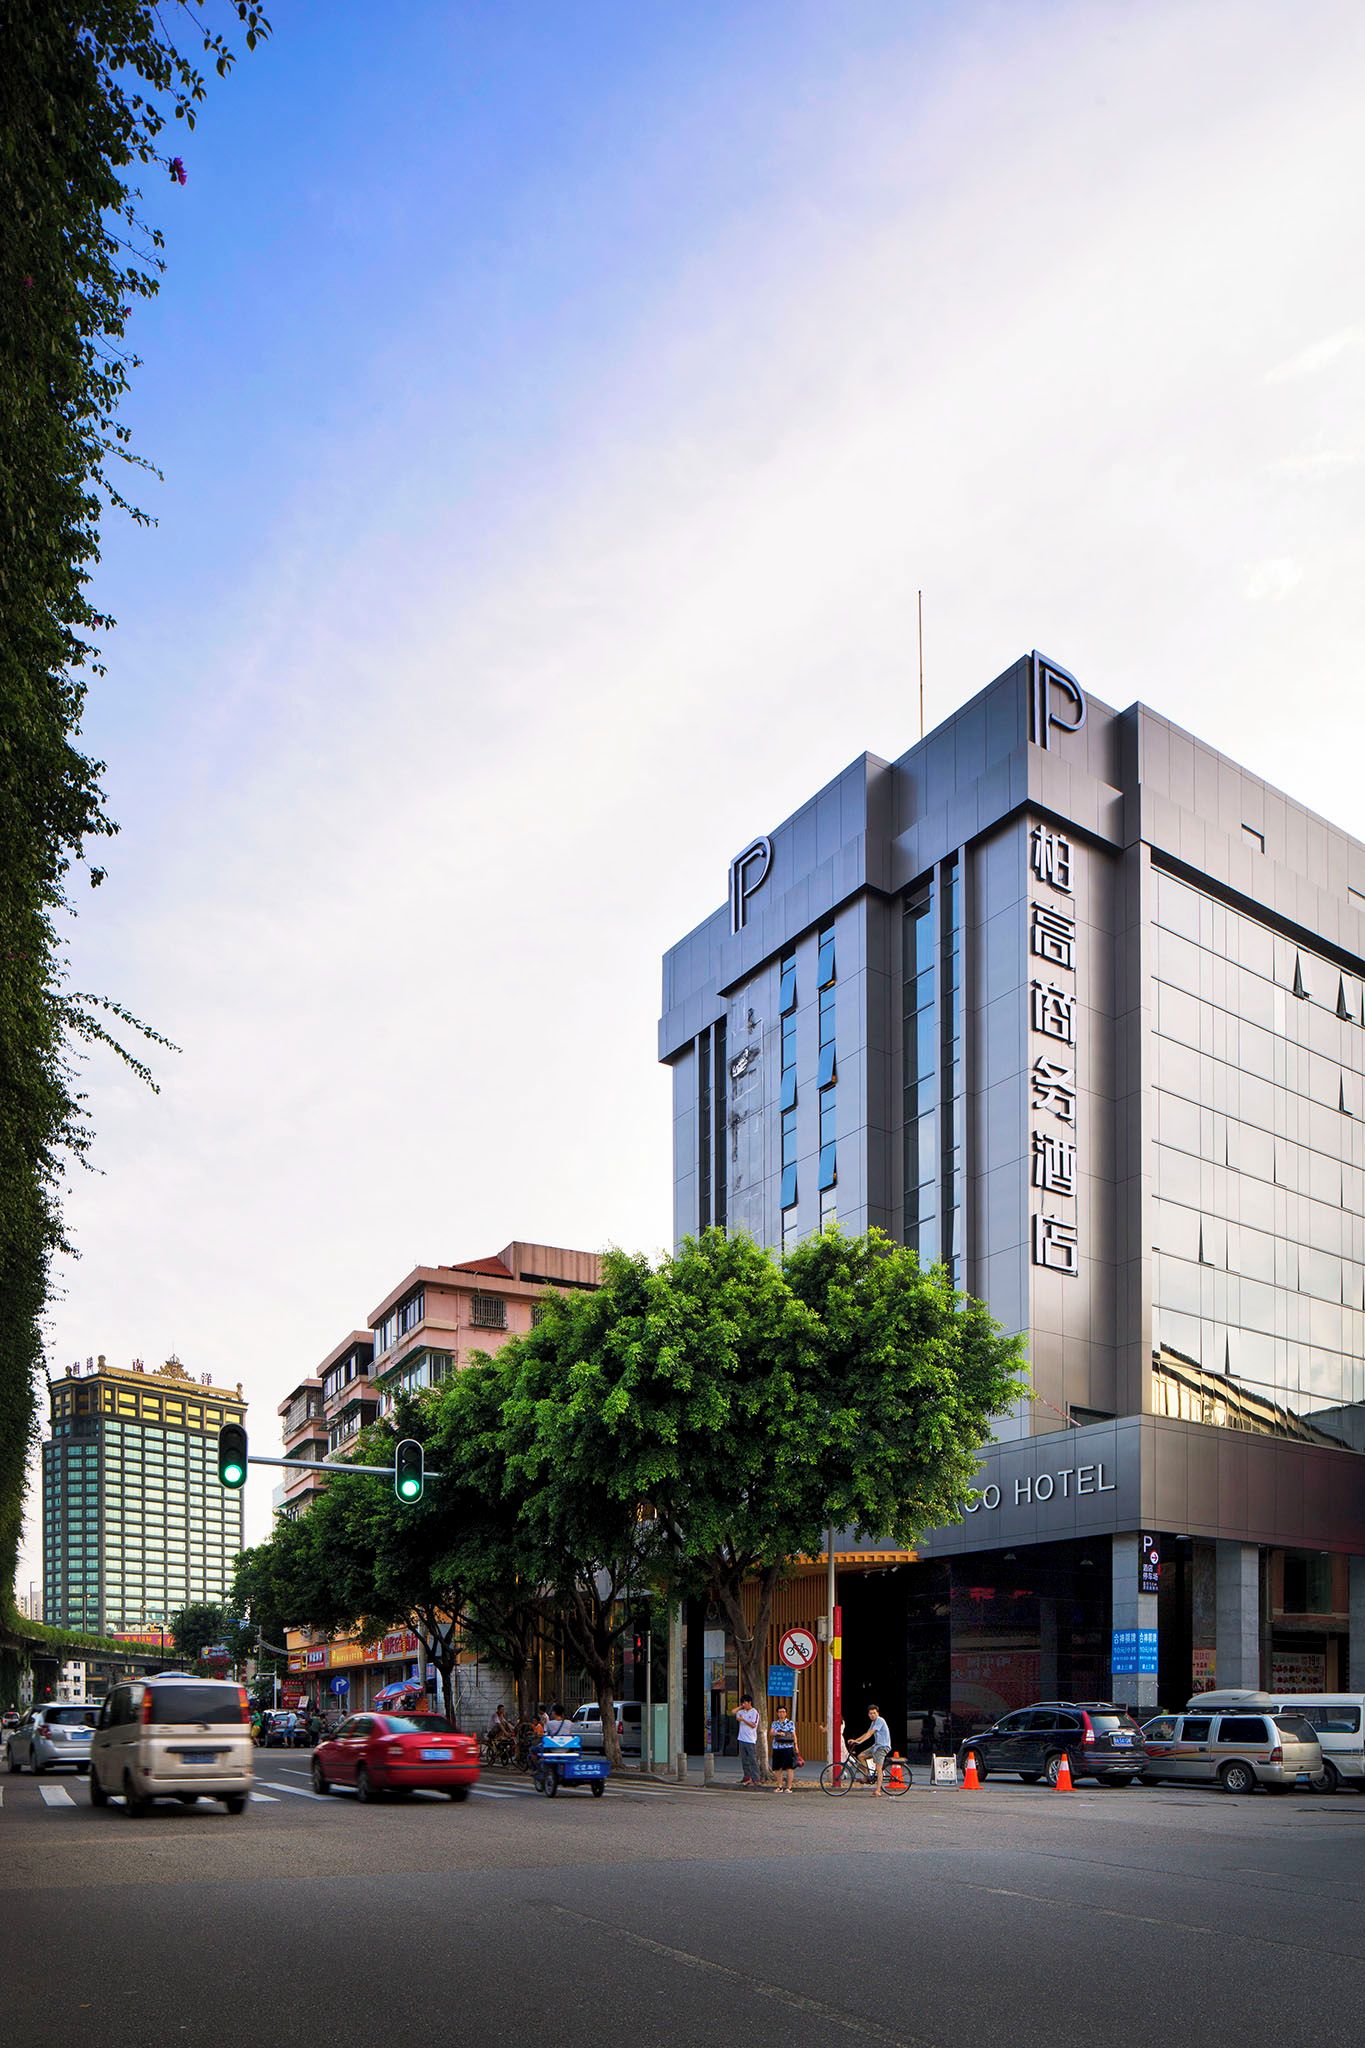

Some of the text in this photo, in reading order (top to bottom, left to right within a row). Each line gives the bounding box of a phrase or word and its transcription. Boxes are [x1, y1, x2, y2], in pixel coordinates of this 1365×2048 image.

[1030, 823, 1078, 1279] 柏高商务酒店
[1014, 1463, 1117, 1507] HOTEL
[1143, 1535, 1154, 1553] P
